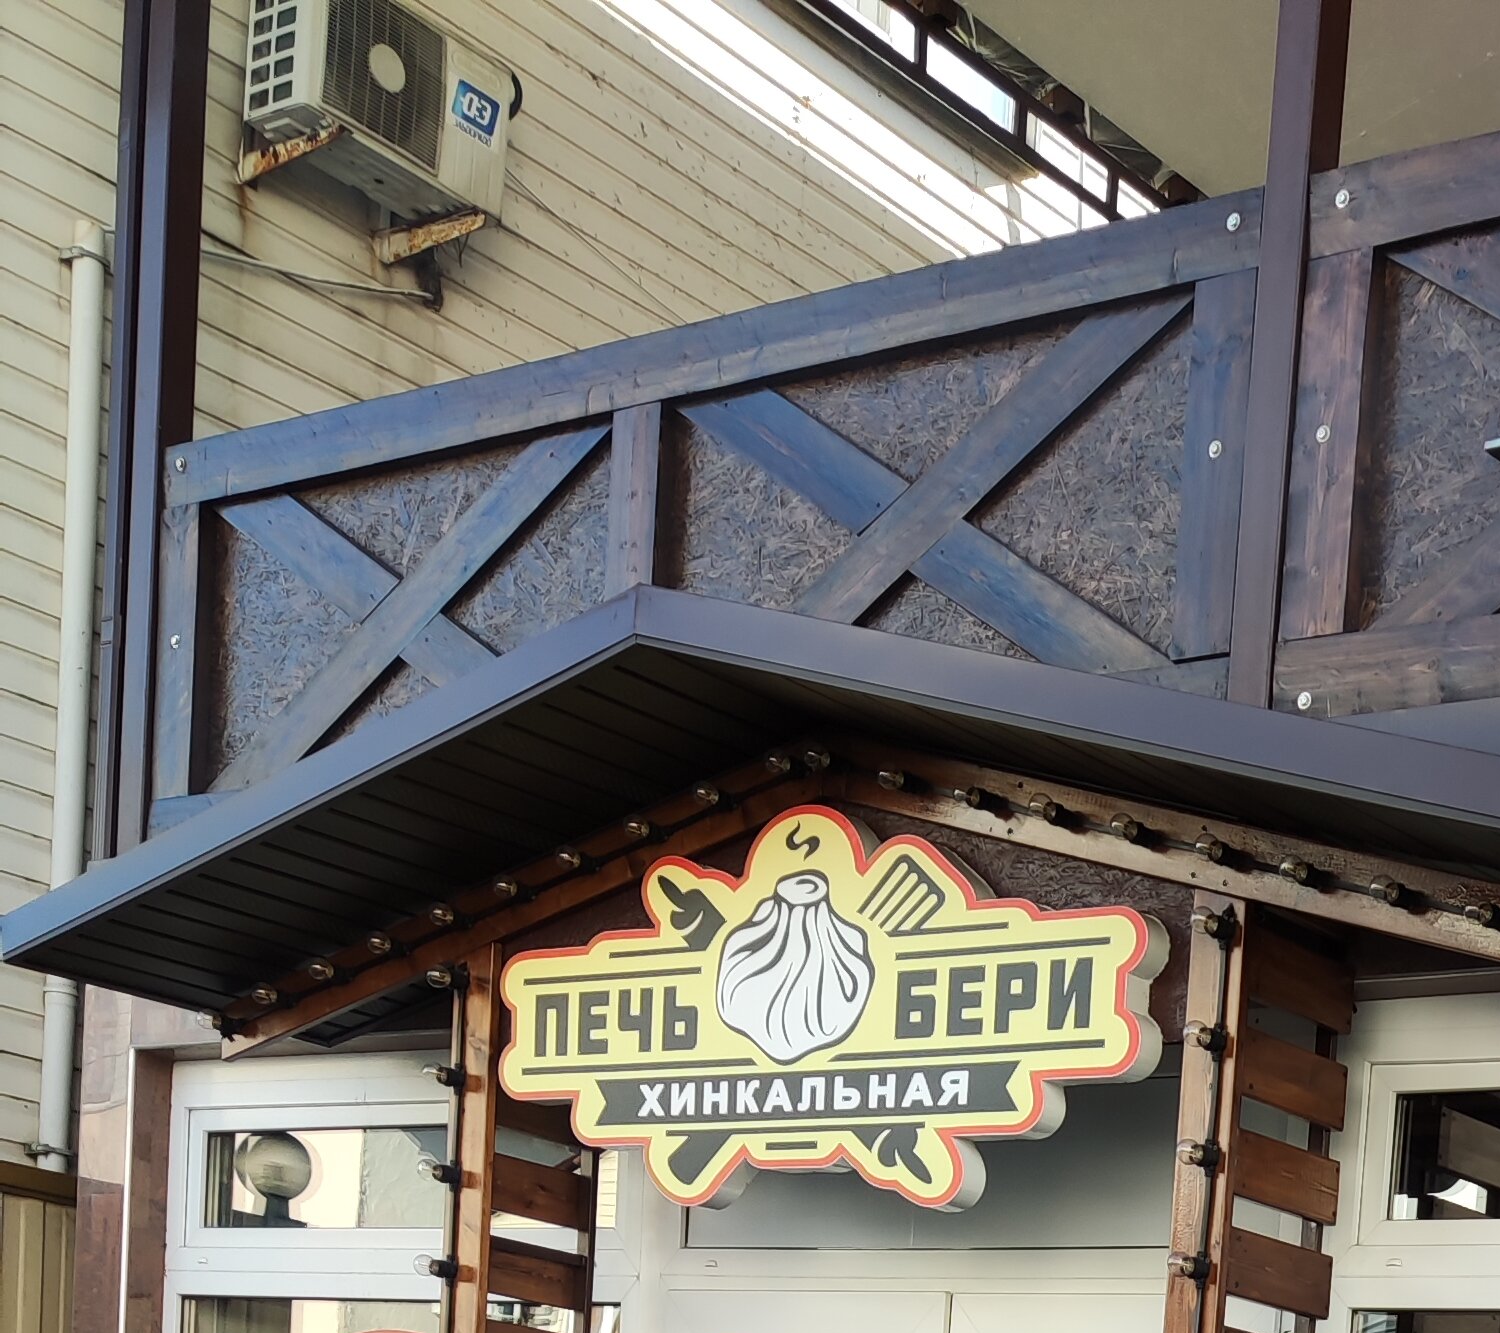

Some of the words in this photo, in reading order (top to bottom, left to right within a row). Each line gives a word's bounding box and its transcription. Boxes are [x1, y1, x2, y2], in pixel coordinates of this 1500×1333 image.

[532, 985, 699, 1058] ПЕЧЬ
[894, 956, 1094, 1040] БЕРИ
[637, 1069, 970, 1118] ХИНКАЛЬНАЯ
